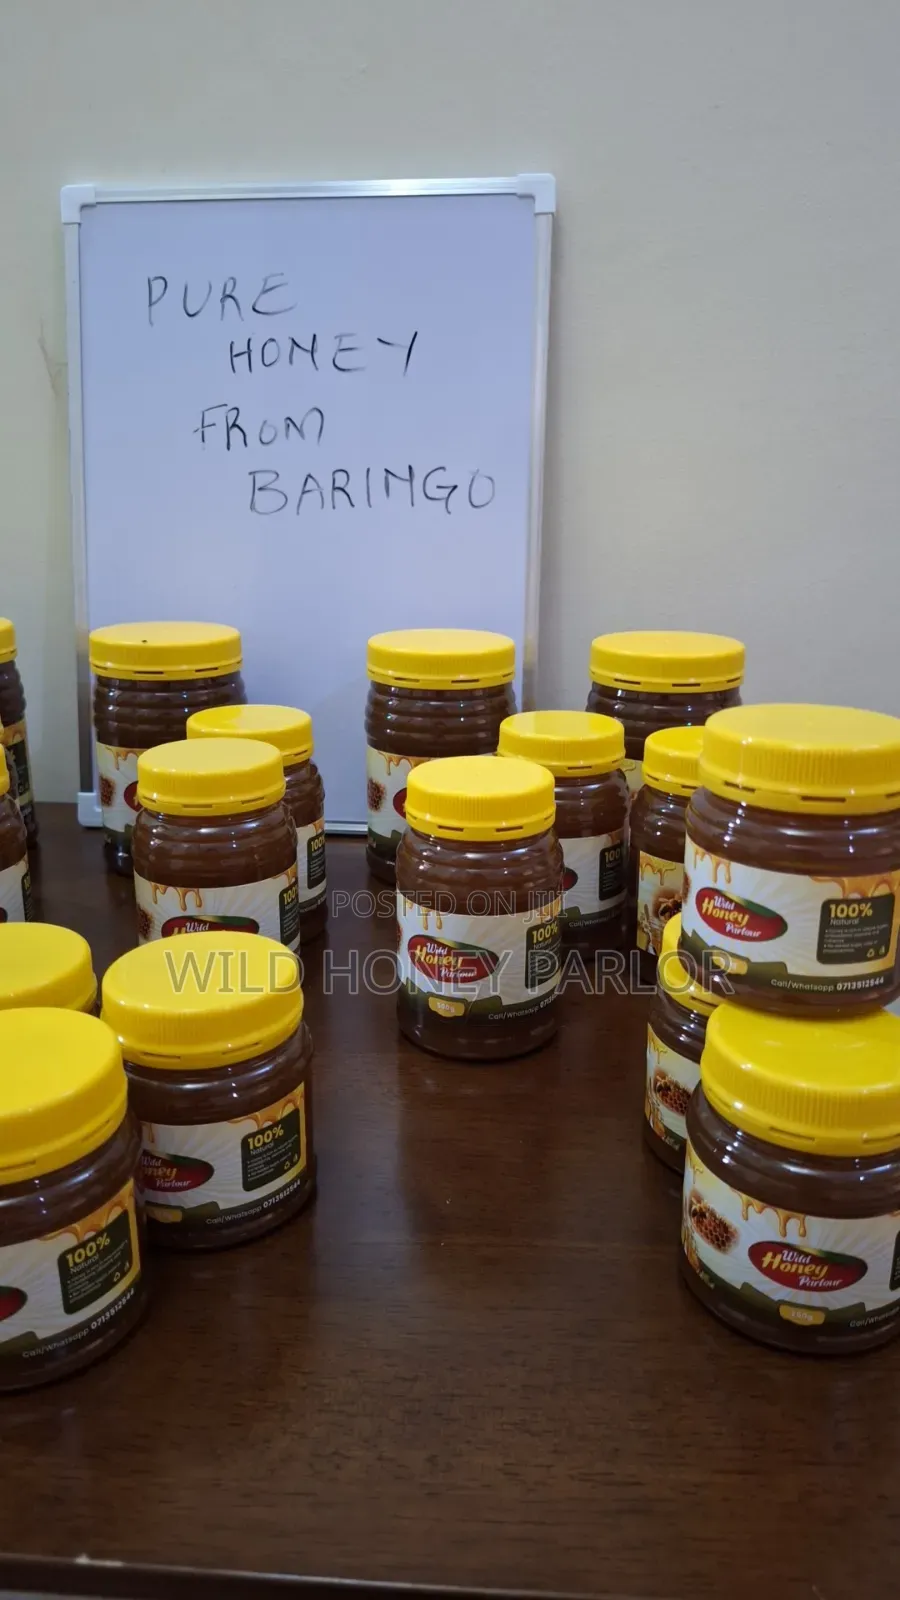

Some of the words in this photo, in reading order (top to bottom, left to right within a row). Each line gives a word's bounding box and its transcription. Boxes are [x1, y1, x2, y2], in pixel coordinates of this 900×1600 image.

[148, 272, 298, 327] PURE
[229, 331, 418, 377] HONEY
[193, 404, 325, 451] FROM
[247, 464, 496, 516] BARINGO
[702, 896, 749, 927] Honey
[714, 895, 735, 910] Wild
[829, 902, 873, 918] 100%
[185, 921, 209, 933] Wild
[532, 921, 558, 944] 100%
[725, 921, 761, 937] Parlour
[830, 918, 860, 926] Natural
[415, 944, 463, 972] Honey
[248, 1124, 284, 1150] 100%
[66, 1232, 110, 1268] 100%
[782, 1250, 811, 1264] Wild
[70, 1253, 99, 1274] Natural
[761, 1251, 828, 1280] Honey
[799, 1275, 843, 1287] Parlour
